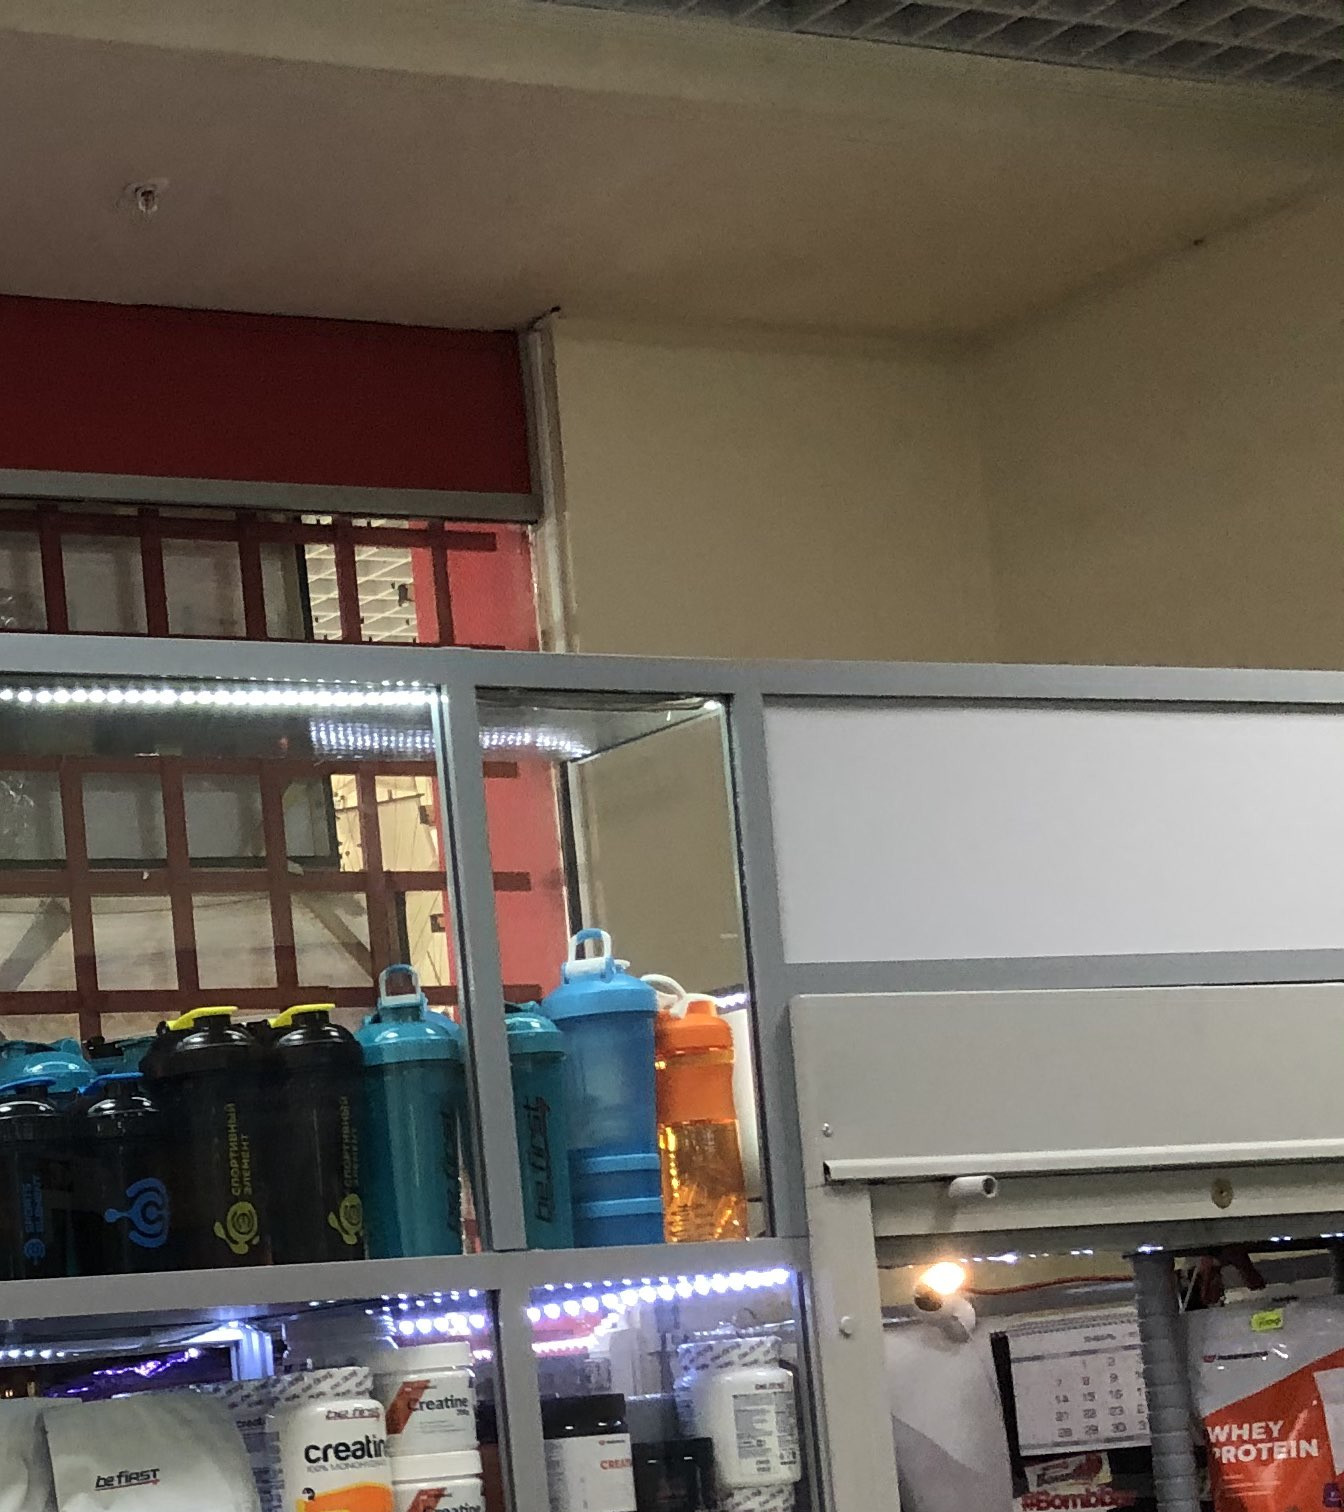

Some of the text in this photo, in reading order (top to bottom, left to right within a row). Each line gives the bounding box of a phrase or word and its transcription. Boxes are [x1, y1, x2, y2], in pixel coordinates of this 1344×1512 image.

[225, 1103, 240, 1196] СПОРТИВНЫЙ
[409, 1394, 469, 1413] Creatine
[1209, 1420, 1284, 1442] WHEY
